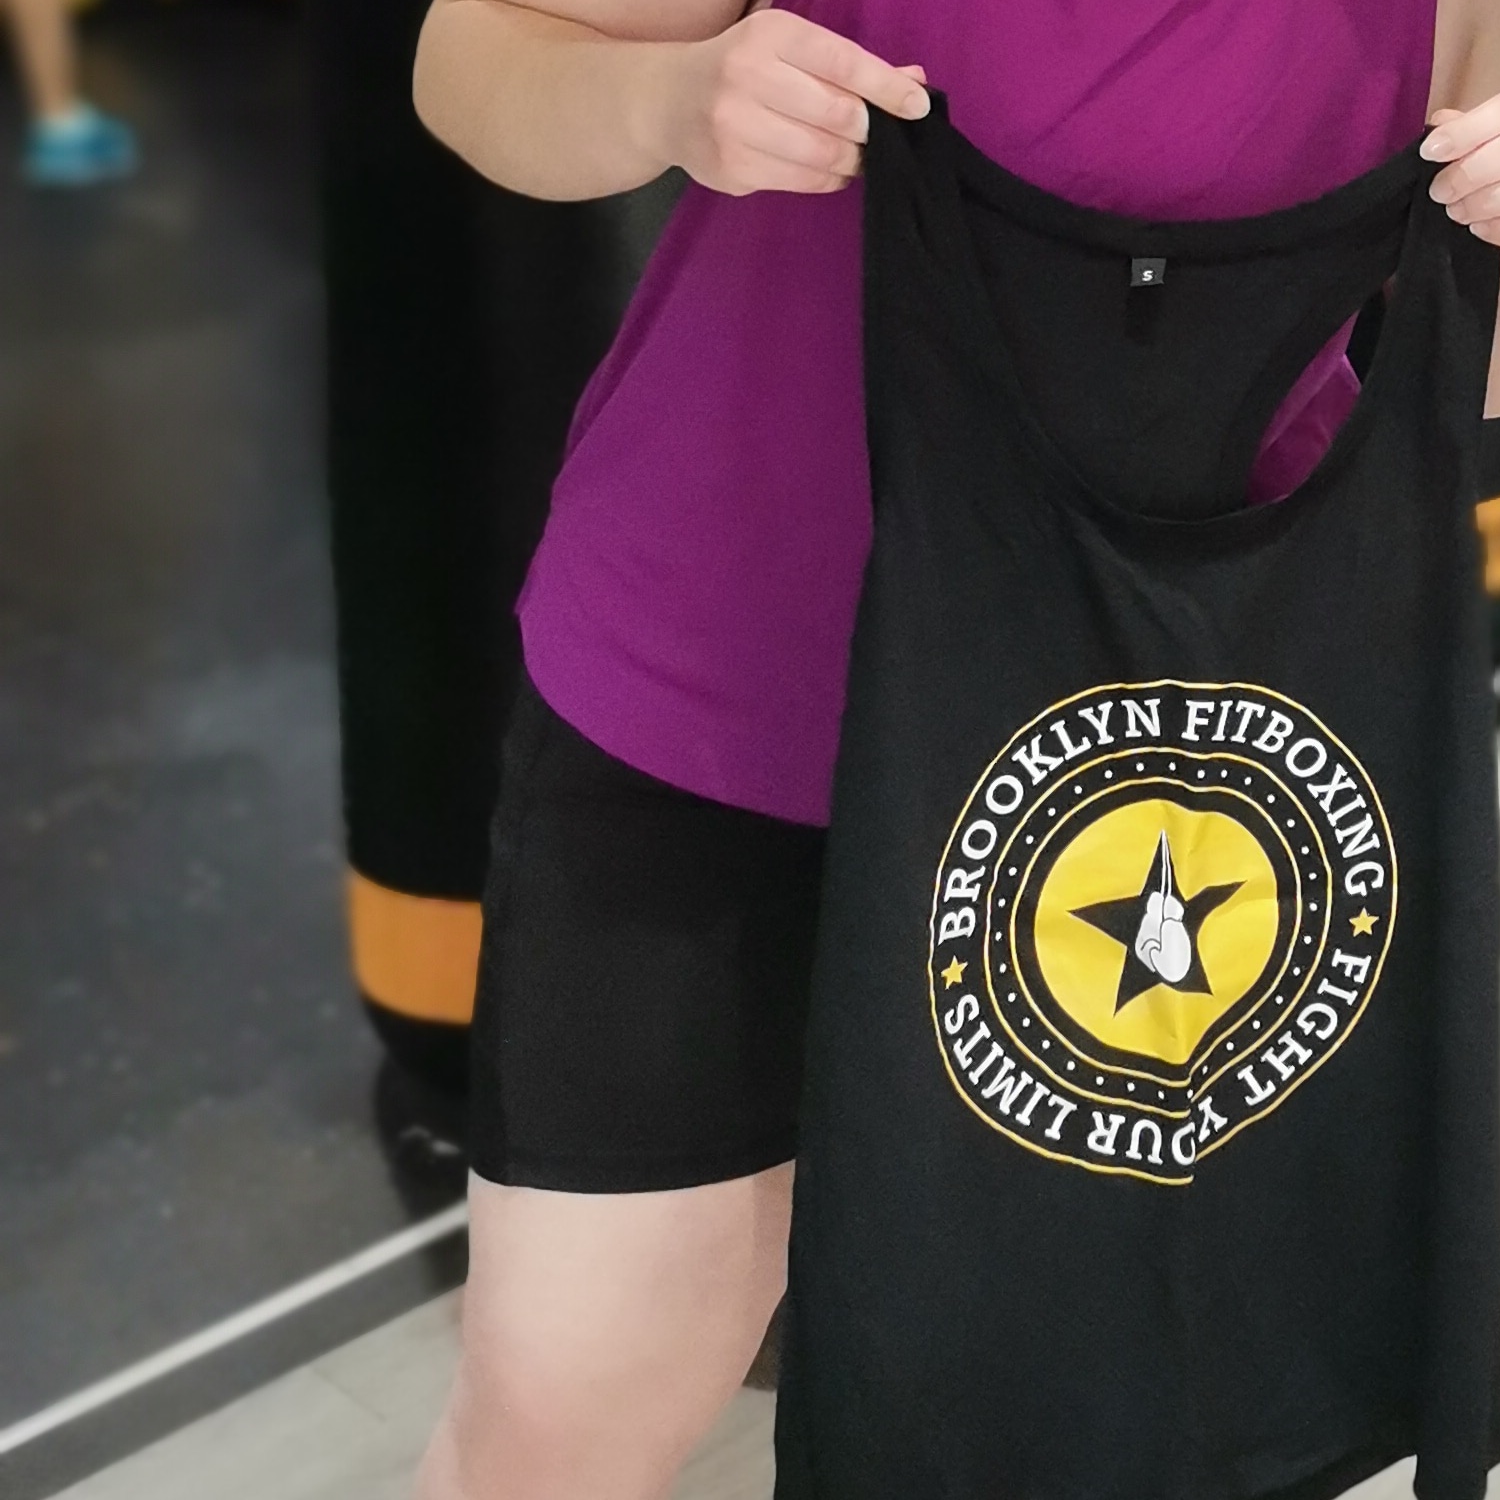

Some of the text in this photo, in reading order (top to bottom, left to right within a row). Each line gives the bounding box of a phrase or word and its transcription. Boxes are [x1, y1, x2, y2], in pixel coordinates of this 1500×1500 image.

[1141, 269, 1155, 282] S
[937, 698, 1385, 947] BROOKLYN FITBOXING
[943, 993, 1078, 1141] LIMITS
[1237, 947, 1372, 1107] FIGHT
